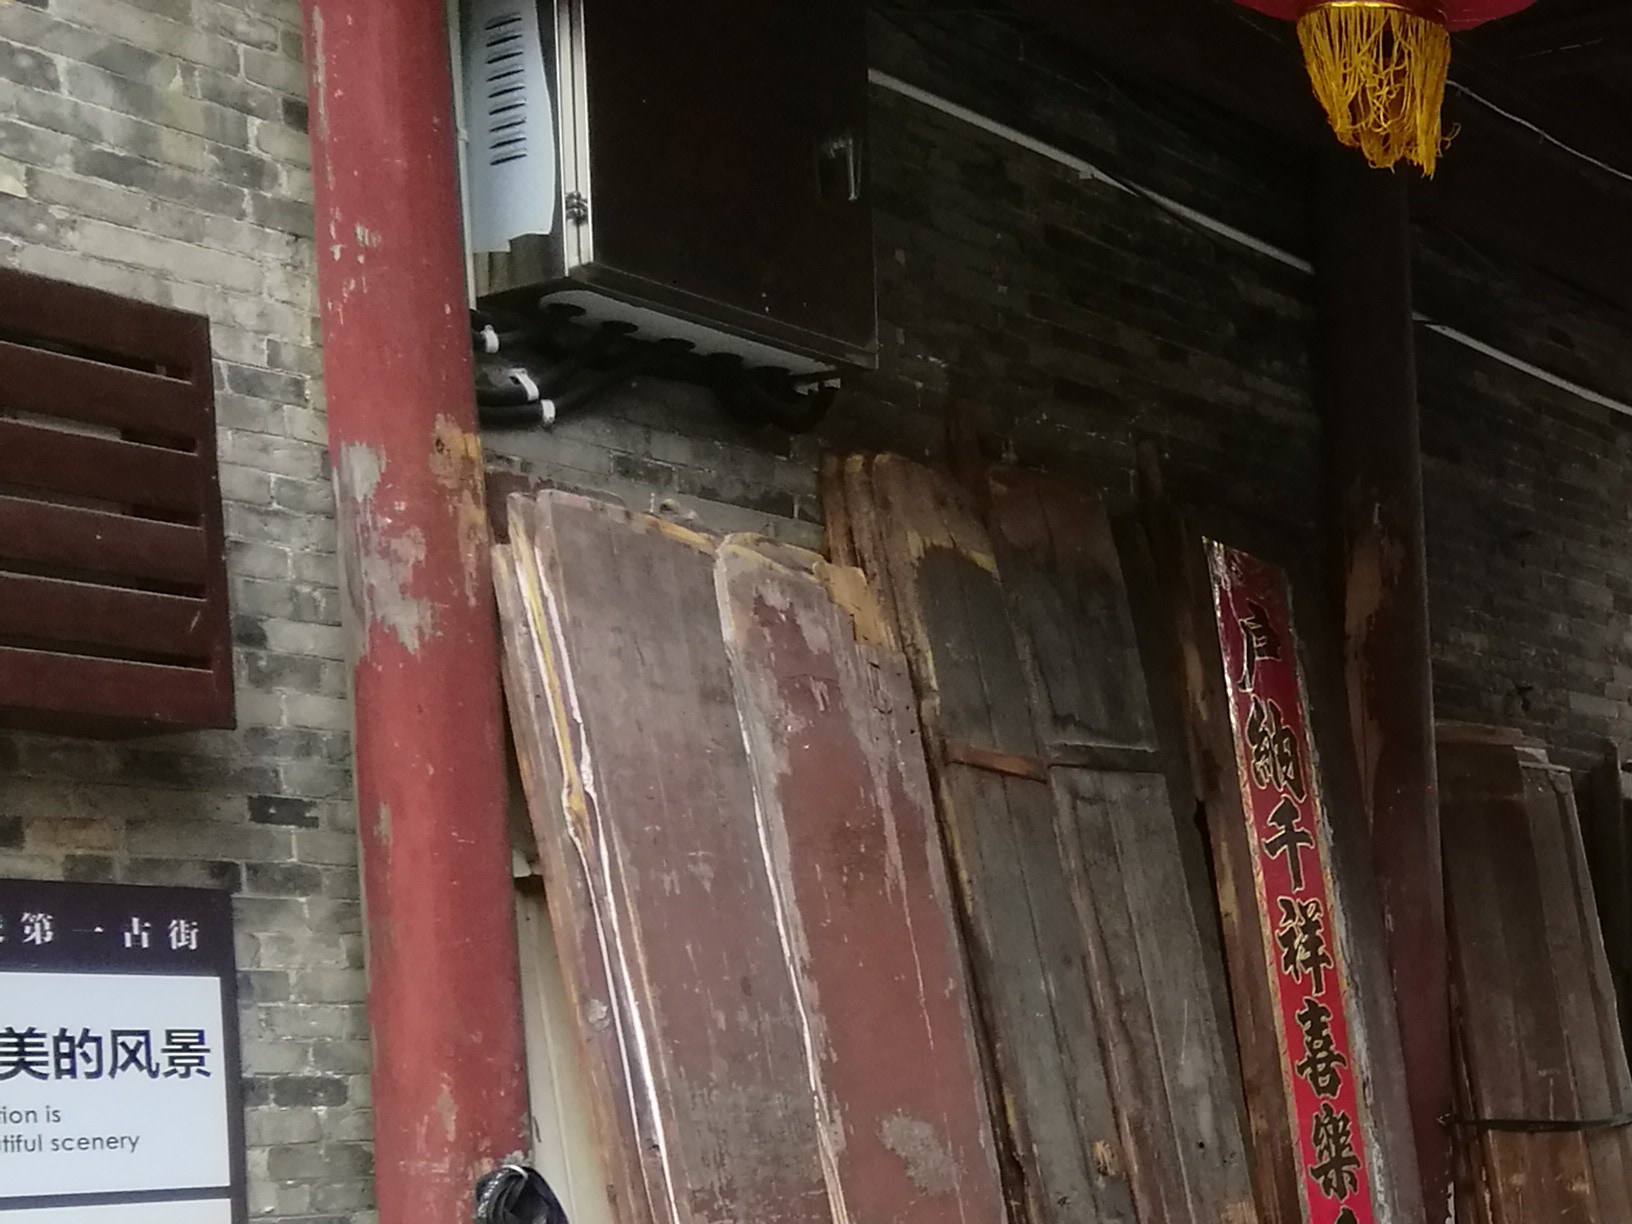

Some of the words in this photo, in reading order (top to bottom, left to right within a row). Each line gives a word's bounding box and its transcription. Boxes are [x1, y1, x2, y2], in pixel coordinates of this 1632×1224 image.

[0, 912, 199, 950] 第一古街
[0, 1027, 211, 1081] 美的风景
[45, 1105, 61, 1123] is
[51, 1135, 140, 1153] scenery
